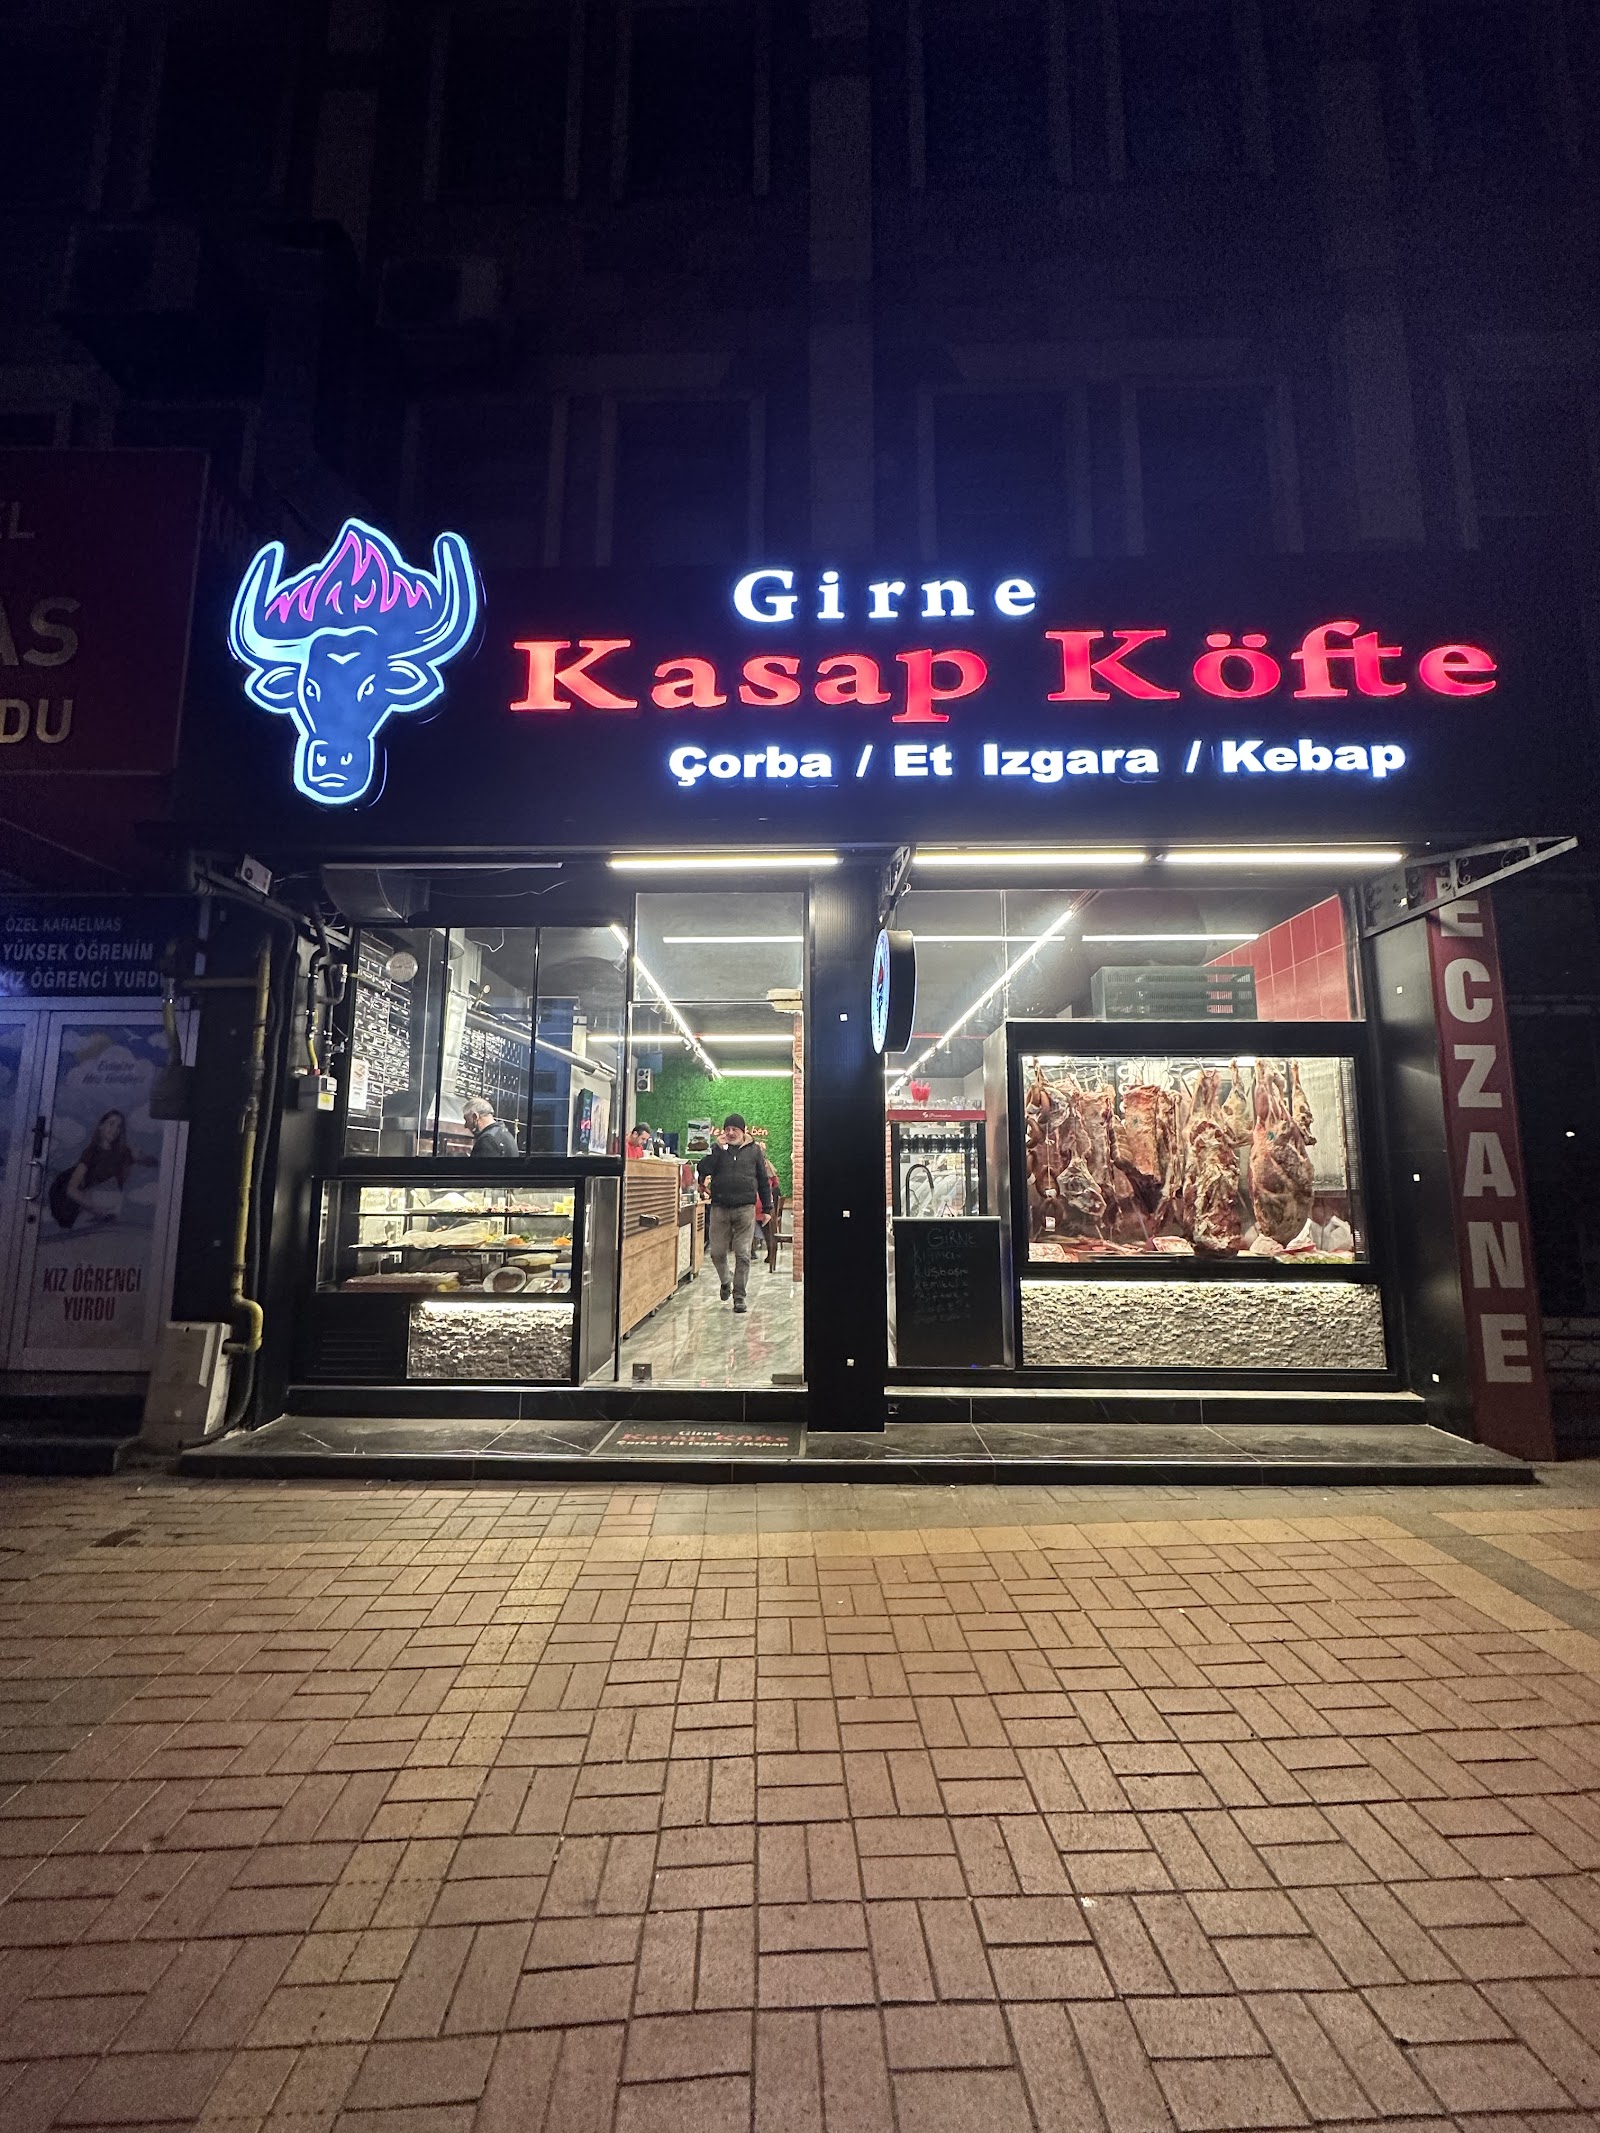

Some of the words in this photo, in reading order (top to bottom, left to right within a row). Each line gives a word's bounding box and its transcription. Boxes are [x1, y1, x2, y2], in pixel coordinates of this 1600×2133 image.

[734, 570, 1036, 622] Girne
[509, 638, 988, 723] Kasap
[1045, 621, 1498, 702] Köfte
[669, 745, 833, 786] Çorba
[856, 744, 874, 777] /
[895, 745, 953, 776] Et
[983, 744, 1159, 783] Izgara
[1185, 740, 1203, 773] /
[1222, 739, 1406, 777] Kebap
[5, 915, 38, 933] ÖZEL
[43, 917, 122, 933] KARAELMAS
[3, 939, 69, 961] YÜKSEK
[74, 938, 154, 961] ÖĞRENİM
[31, 967, 108, 989] ÖĞRENCİ
[1435, 876, 1533, 1383] ECZANE
[64, 1296, 115, 1321] YURDU
